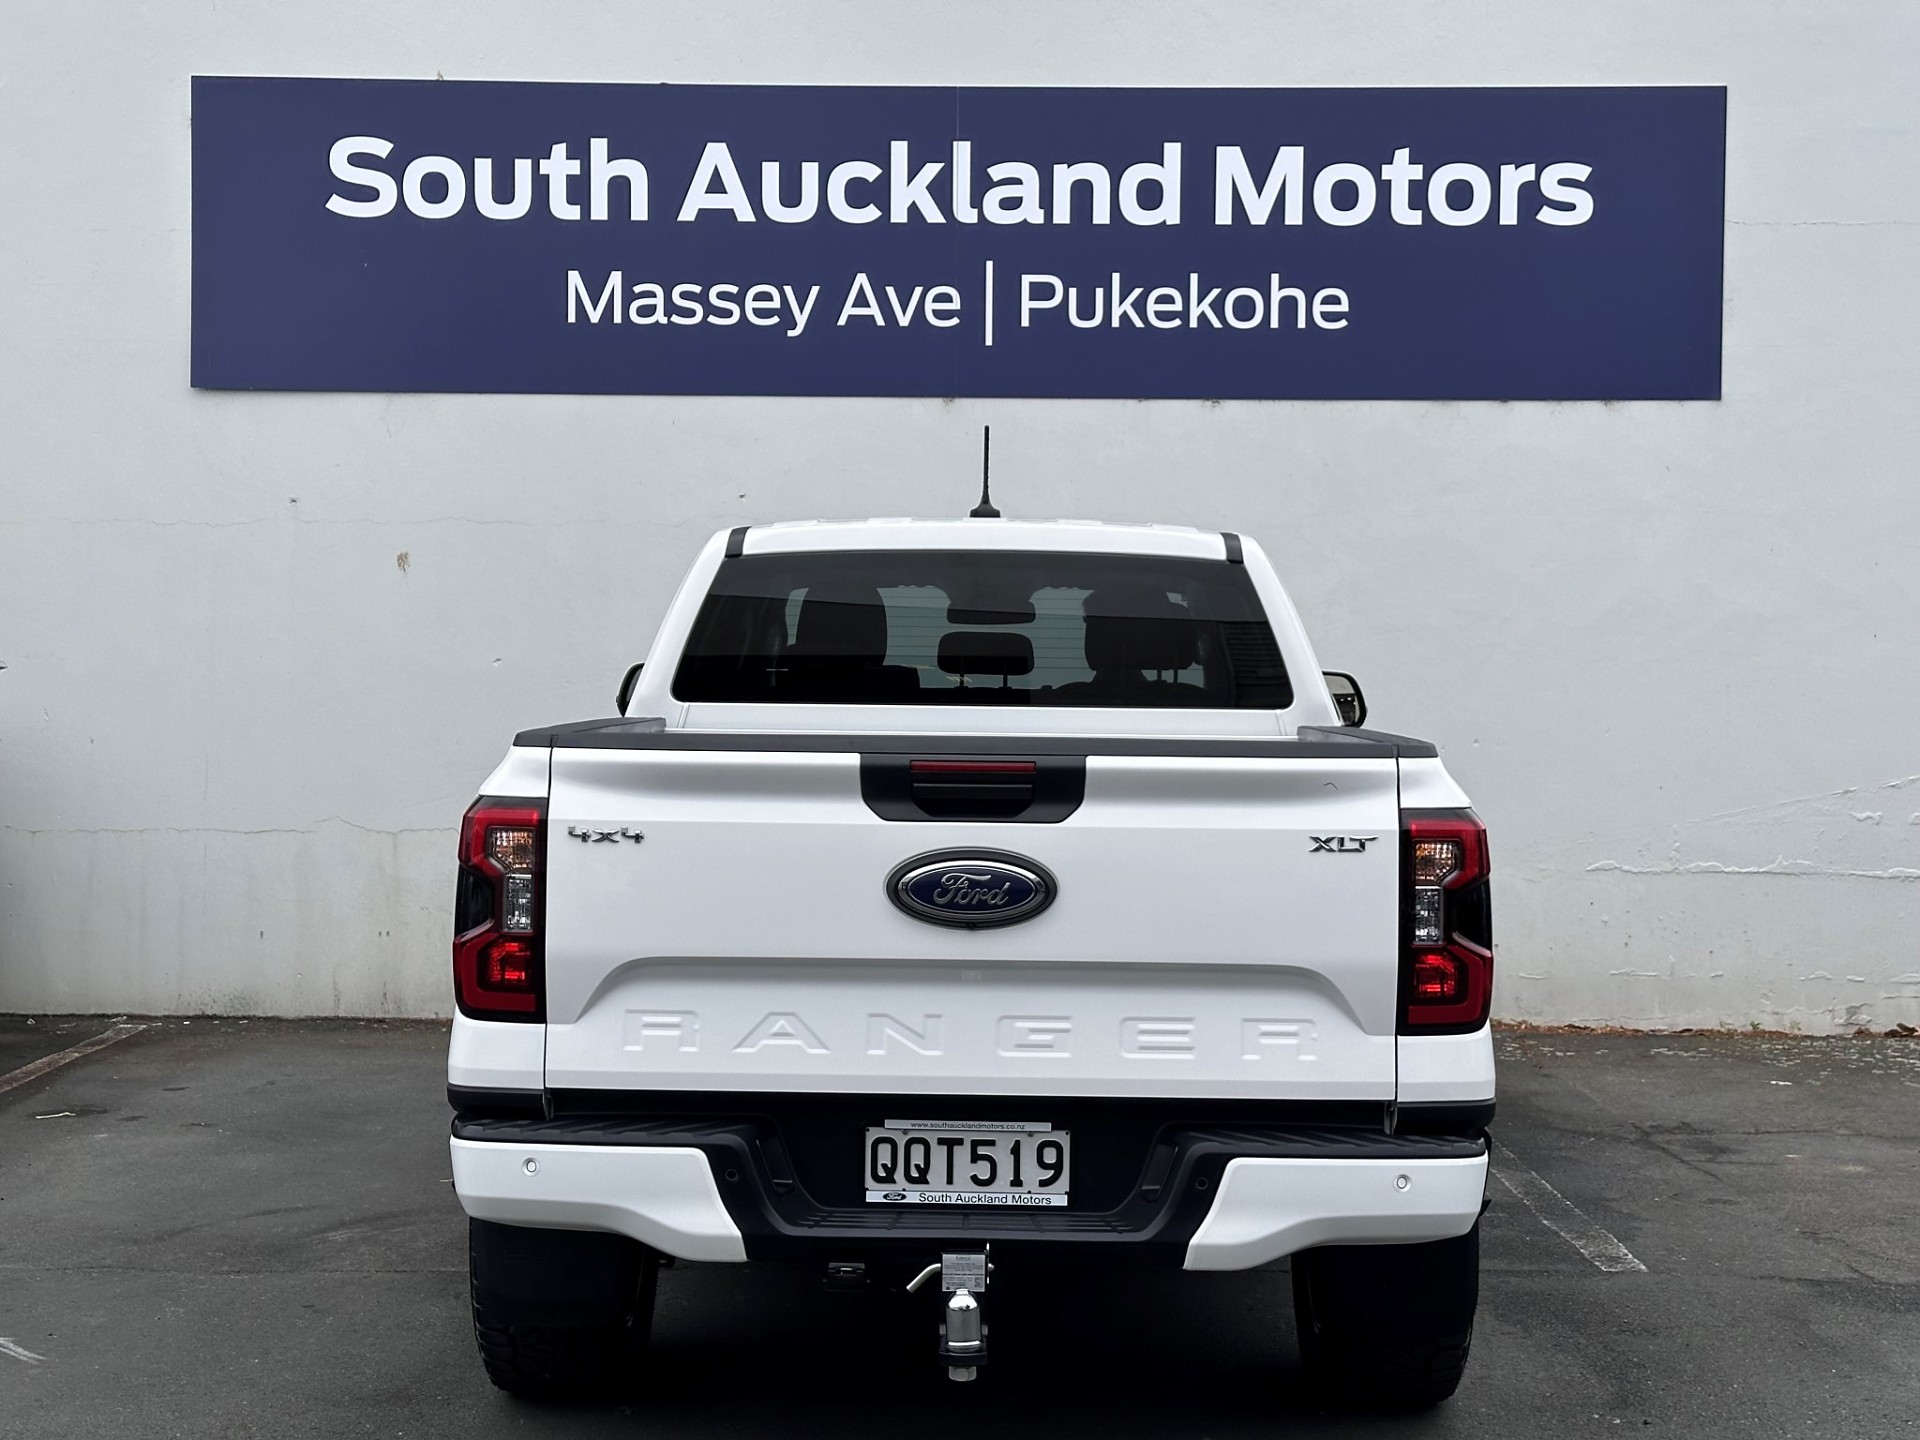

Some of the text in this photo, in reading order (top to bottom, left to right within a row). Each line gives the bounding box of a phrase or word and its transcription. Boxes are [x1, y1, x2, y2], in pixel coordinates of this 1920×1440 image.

[325, 136, 1594, 227] South Auckland Motors
[567, 270, 1350, 337] Massey Ave Pukekohe
[1308, 835, 1378, 852] XLT
[933, 872, 1010, 905] Ford
[622, 1009, 1318, 1061] RANGER
[910, 1121, 1026, 1131] www.southaucklandmotors.co.nz
[870, 1136, 1064, 1187] QQT519
[918, 1192, 1052, 1205] South Auckland Motors
